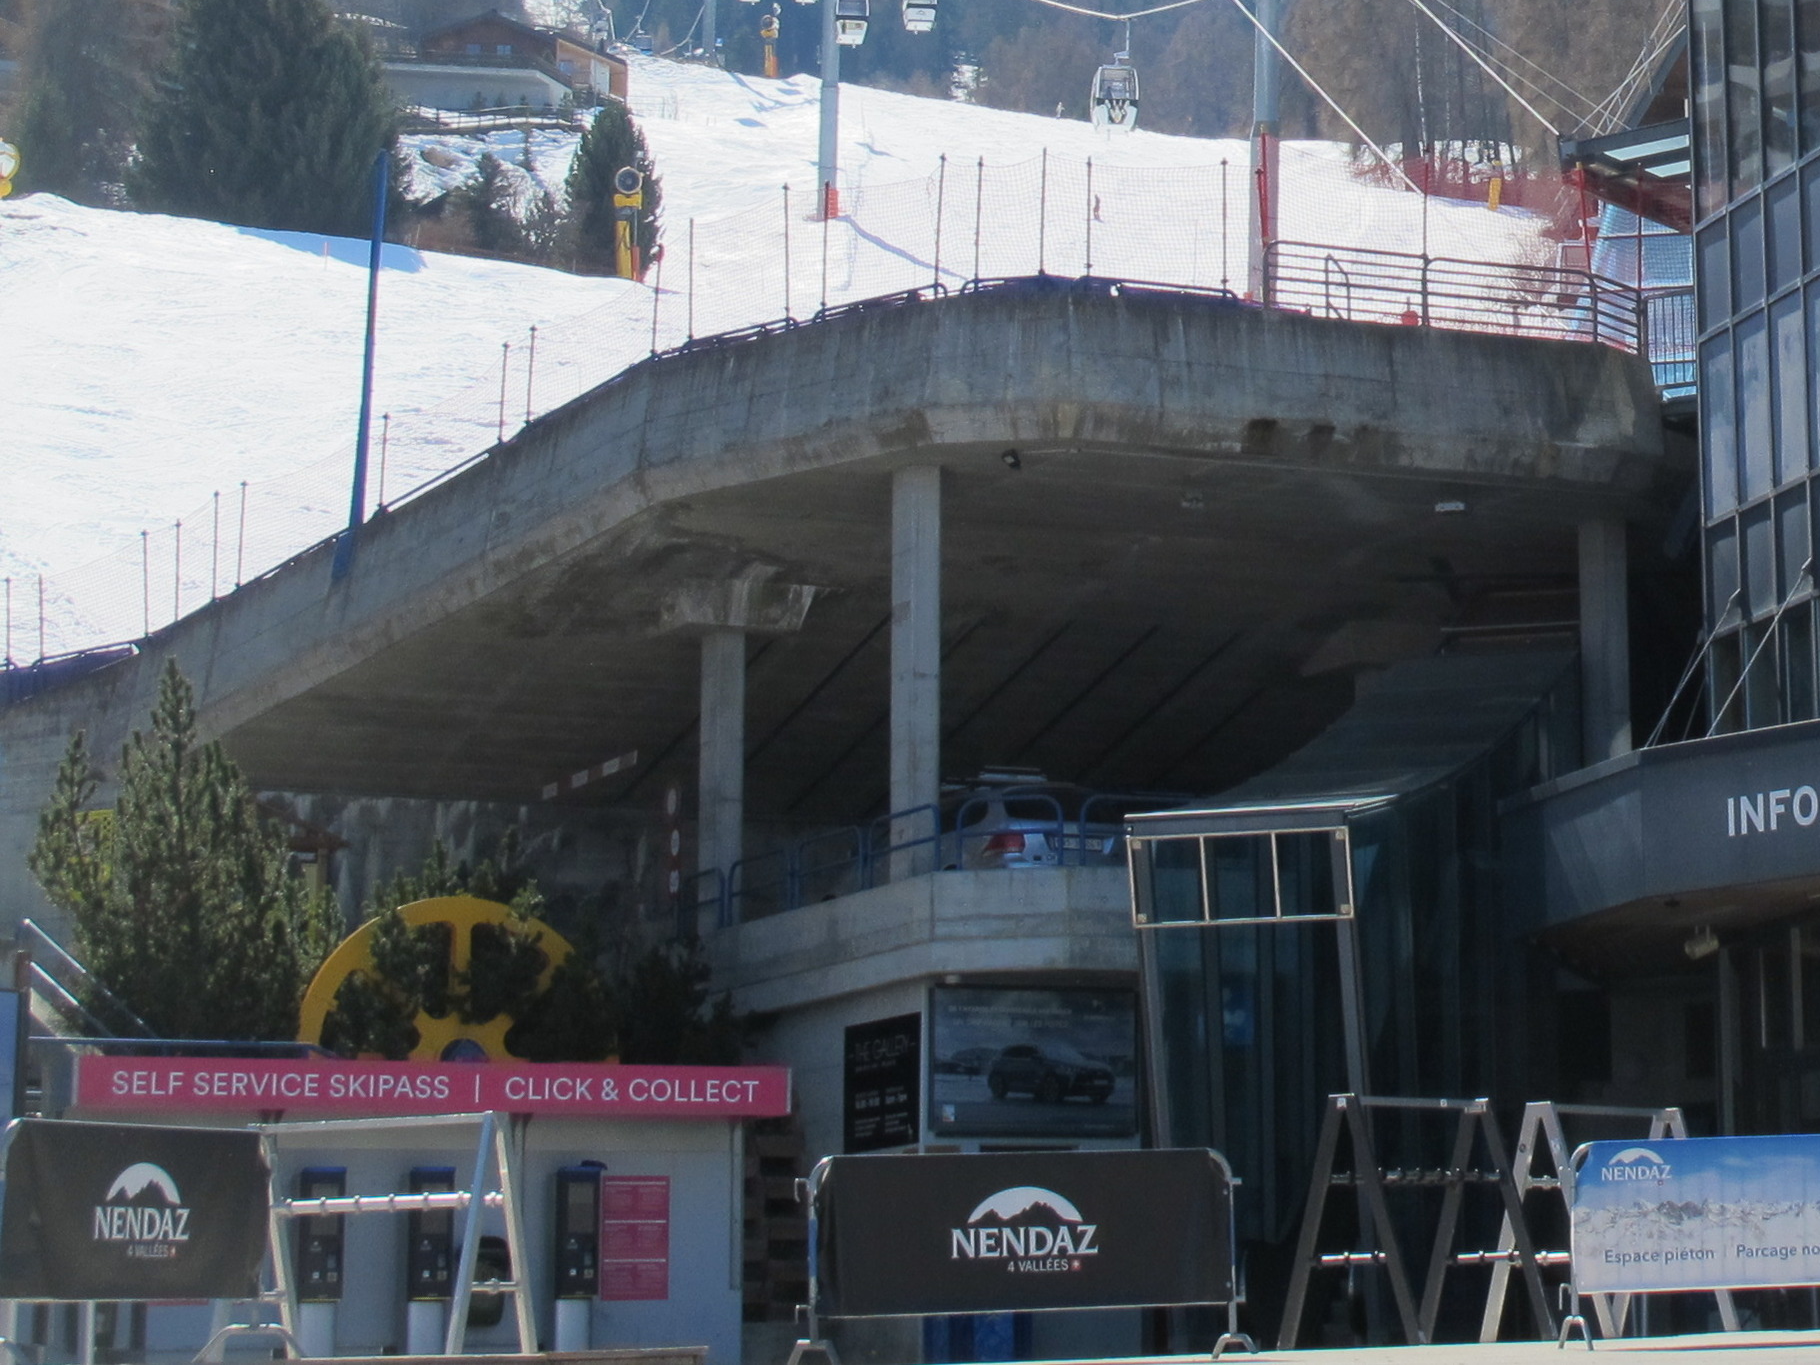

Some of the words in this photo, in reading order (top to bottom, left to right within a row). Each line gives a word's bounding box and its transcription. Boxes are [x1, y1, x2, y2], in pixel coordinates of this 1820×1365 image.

[112, 1070, 184, 1095] SELF
[194, 1071, 319, 1096] SERVICE
[329, 1073, 451, 1099] SKIPASS
[505, 1076, 593, 1101] CLICK
[601, 1078, 619, 1101] &
[628, 1078, 760, 1103] COLLECT
[1601, 1165, 1671, 1181] NENDAZ
[95, 1206, 190, 1240] NENDAZ
[950, 1224, 1099, 1259] NENDAZ
[1604, 1248, 1660, 1266] Espace
[1664, 1245, 1715, 1263] piéton
[1736, 1243, 1797, 1260] Parcage
[1007, 1261, 1015, 1273] 4
[1018, 1257, 1069, 1273] VALLÉES
